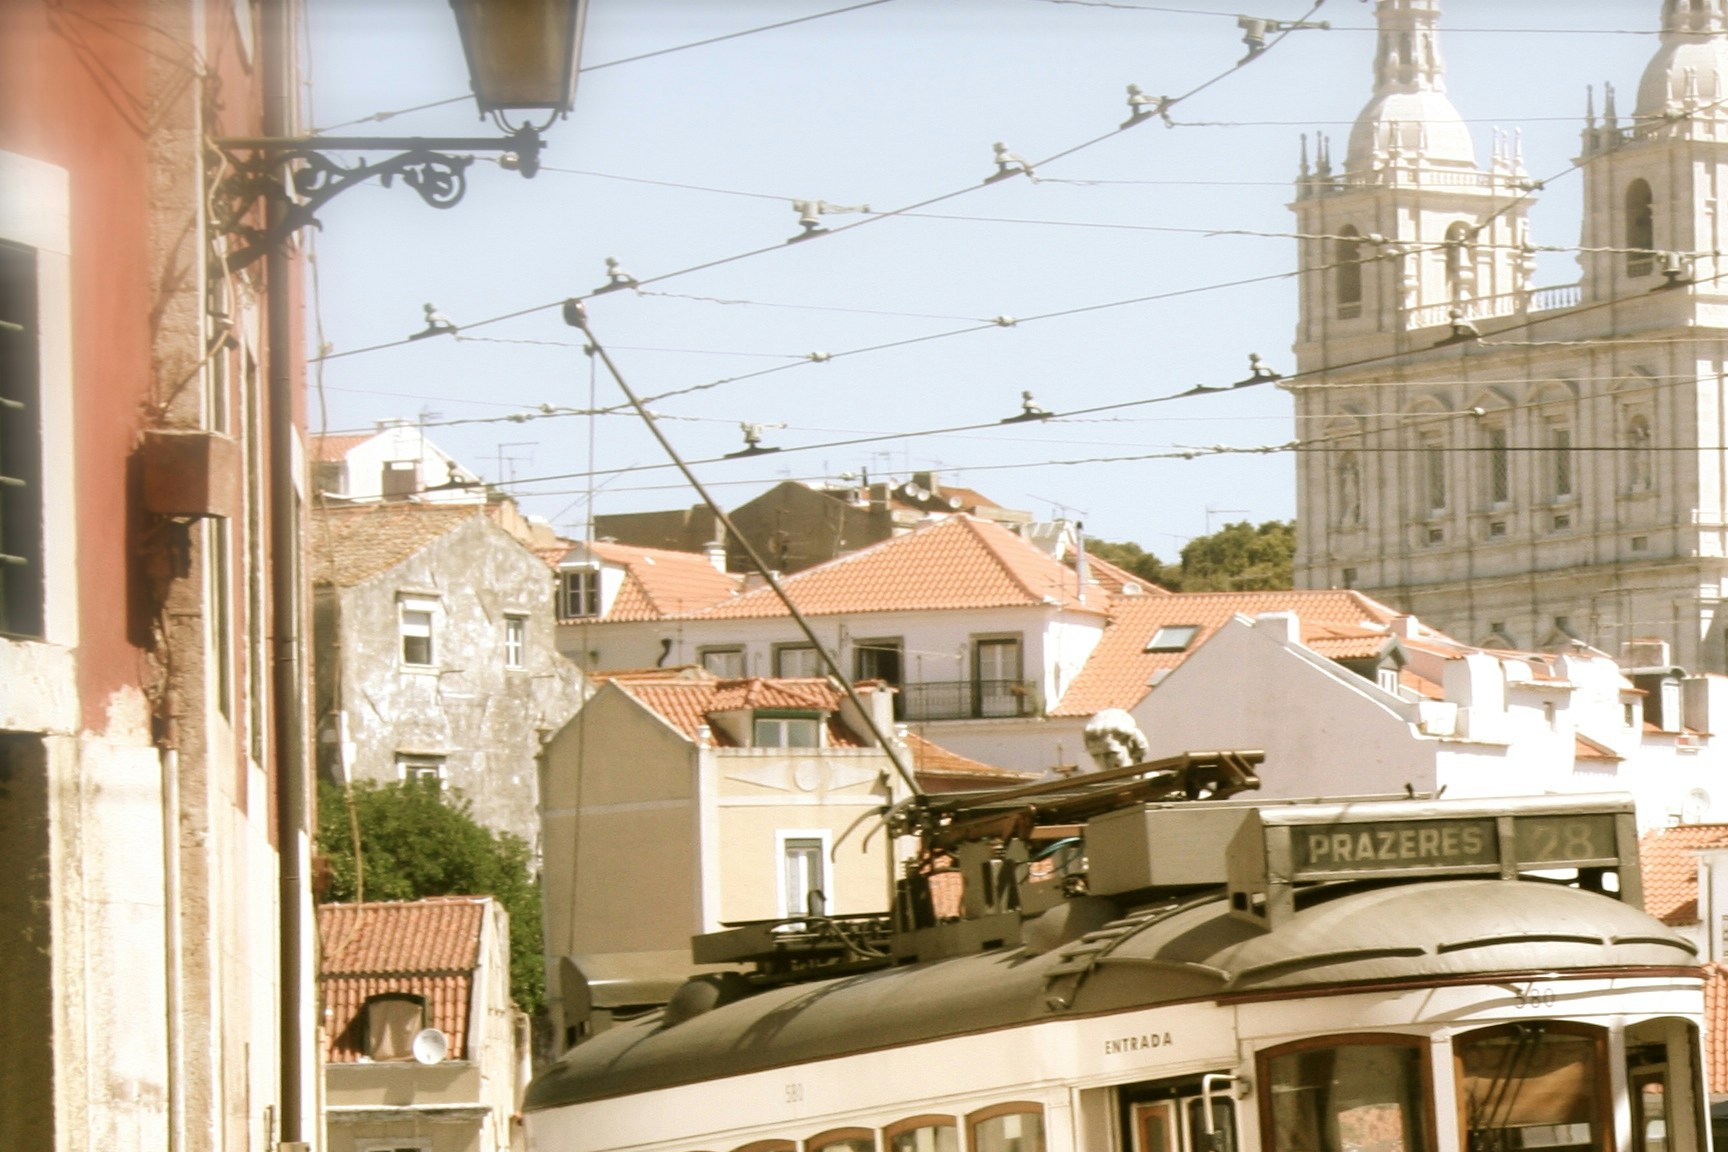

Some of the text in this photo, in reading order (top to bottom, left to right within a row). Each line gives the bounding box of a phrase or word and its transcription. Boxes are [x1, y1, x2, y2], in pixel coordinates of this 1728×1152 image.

[1307, 826, 1484, 864] PRAZERES
[1527, 823, 1594, 860] 28
[1104, 1032, 1173, 1055] ENTRADA
